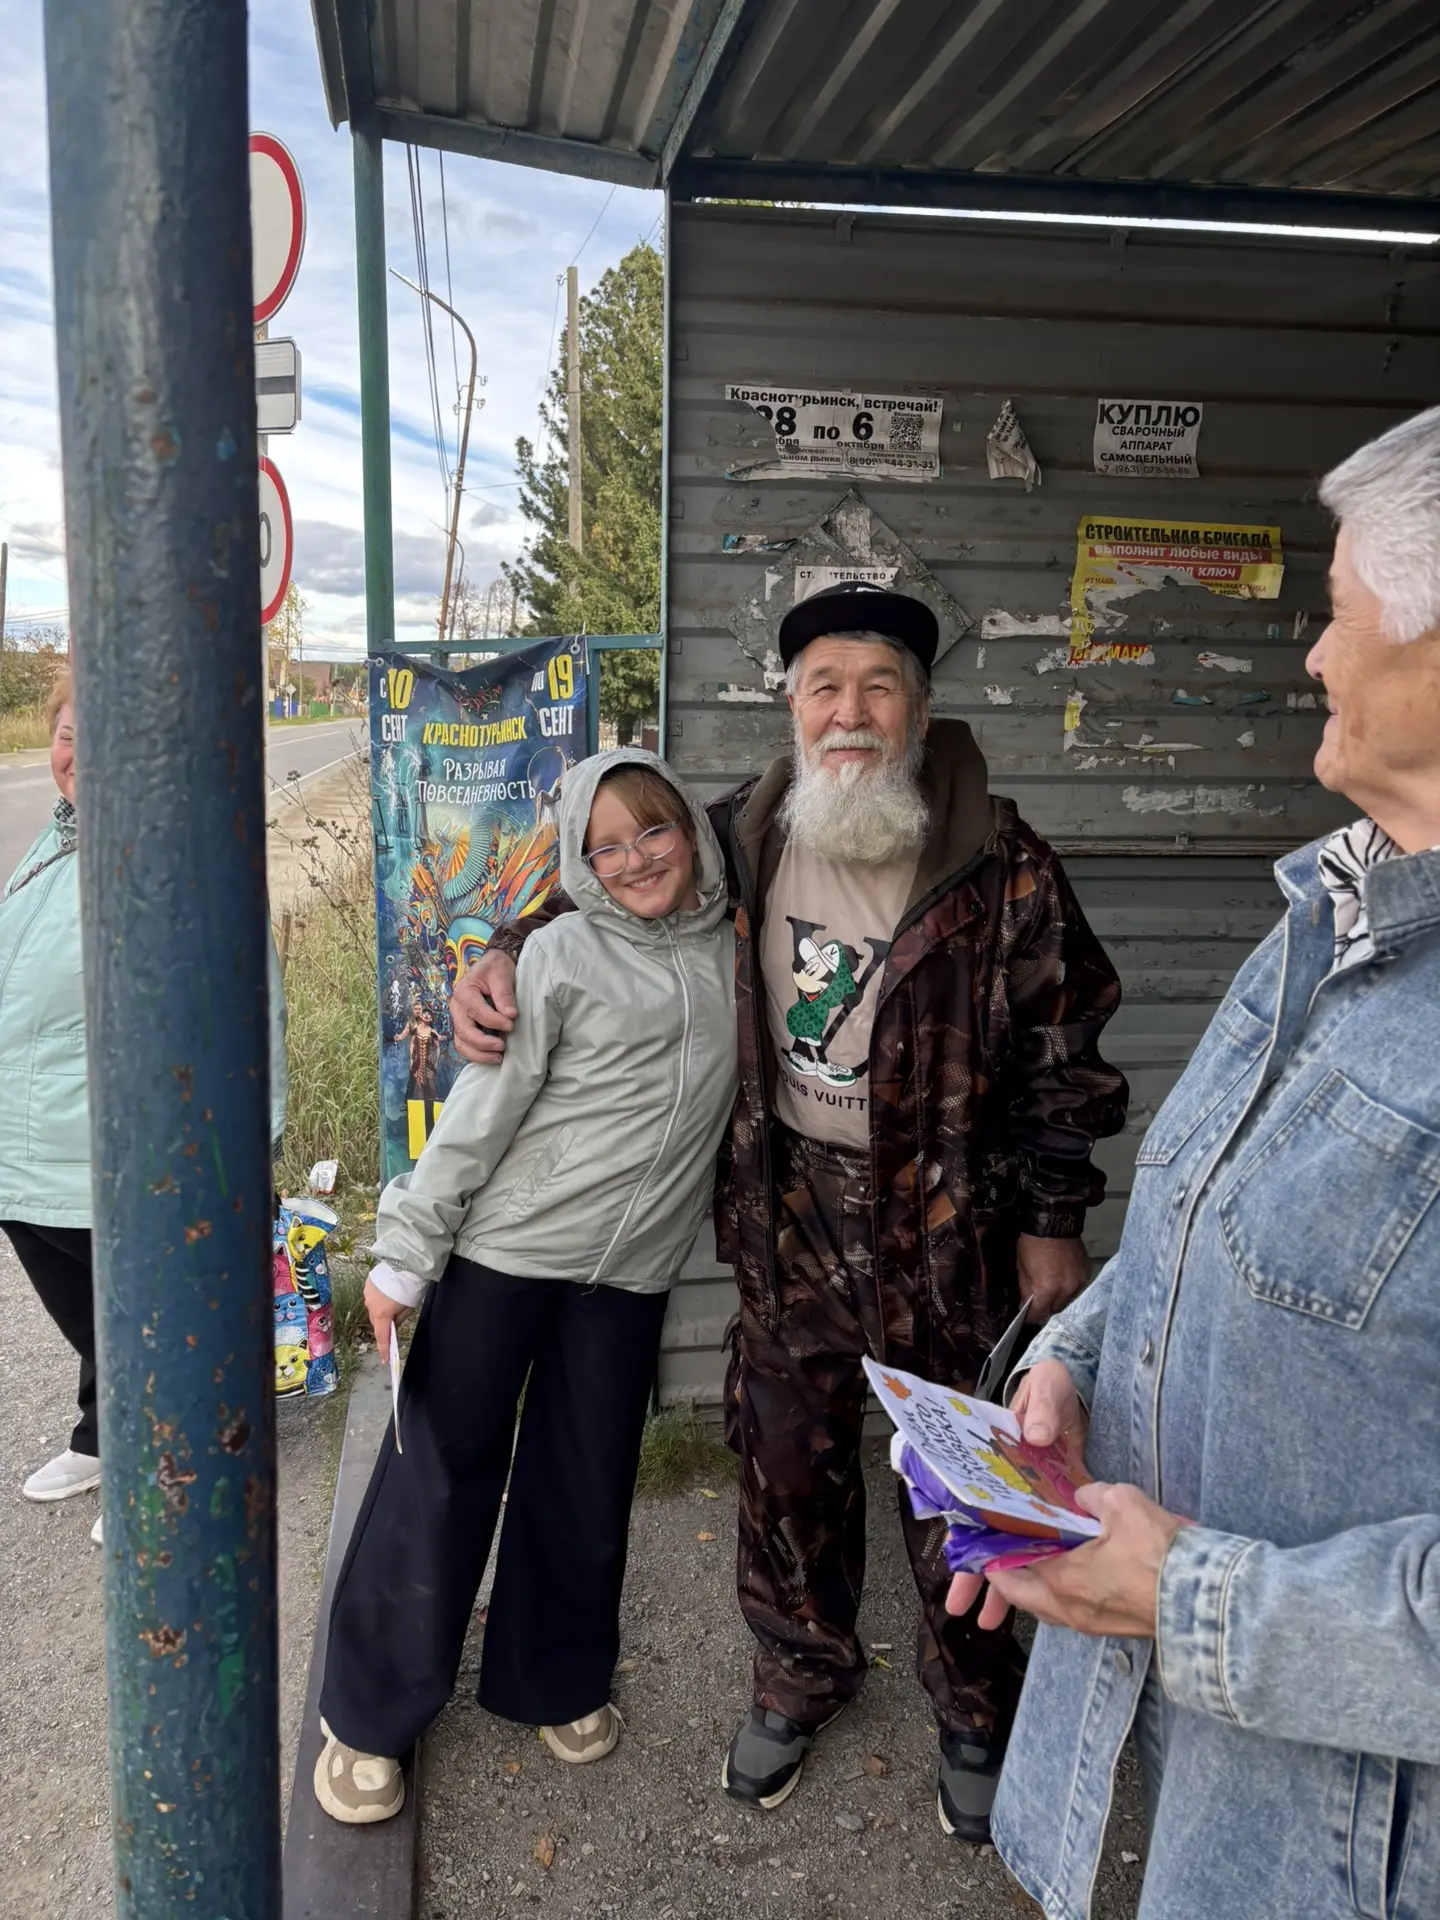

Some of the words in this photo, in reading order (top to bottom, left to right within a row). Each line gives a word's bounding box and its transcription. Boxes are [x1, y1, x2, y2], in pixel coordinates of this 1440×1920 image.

[864, 398, 938, 413] встречай!
[1099, 403, 1200, 427] КУПЛЮ
[813, 425, 841, 440] по
[852, 412, 874, 441] 6
[1112, 426, 1186, 438] СВАРОЧНЫЙ
[836, 440, 885, 451] октября
[1119, 440, 1173, 451] АППАРАТ
[1100, 452, 1192, 465] САМОДЕЛЬНЫЙ
[1115, 464, 1139, 474] (963)
[1085, 523, 1200, 545] СТРОИТЕЛЬНАЯ
[1203, 530, 1272, 548] БРИГАДА
[387, 668, 414, 710] 10
[547, 654, 574, 700] 19
[381, 714, 408, 742] СЕНТ
[422, 715, 528, 748] КРАСНОТУРЬИНСК
[539, 705, 574, 737] СЕНТ
[814, 1088, 868, 1111] VUITT
